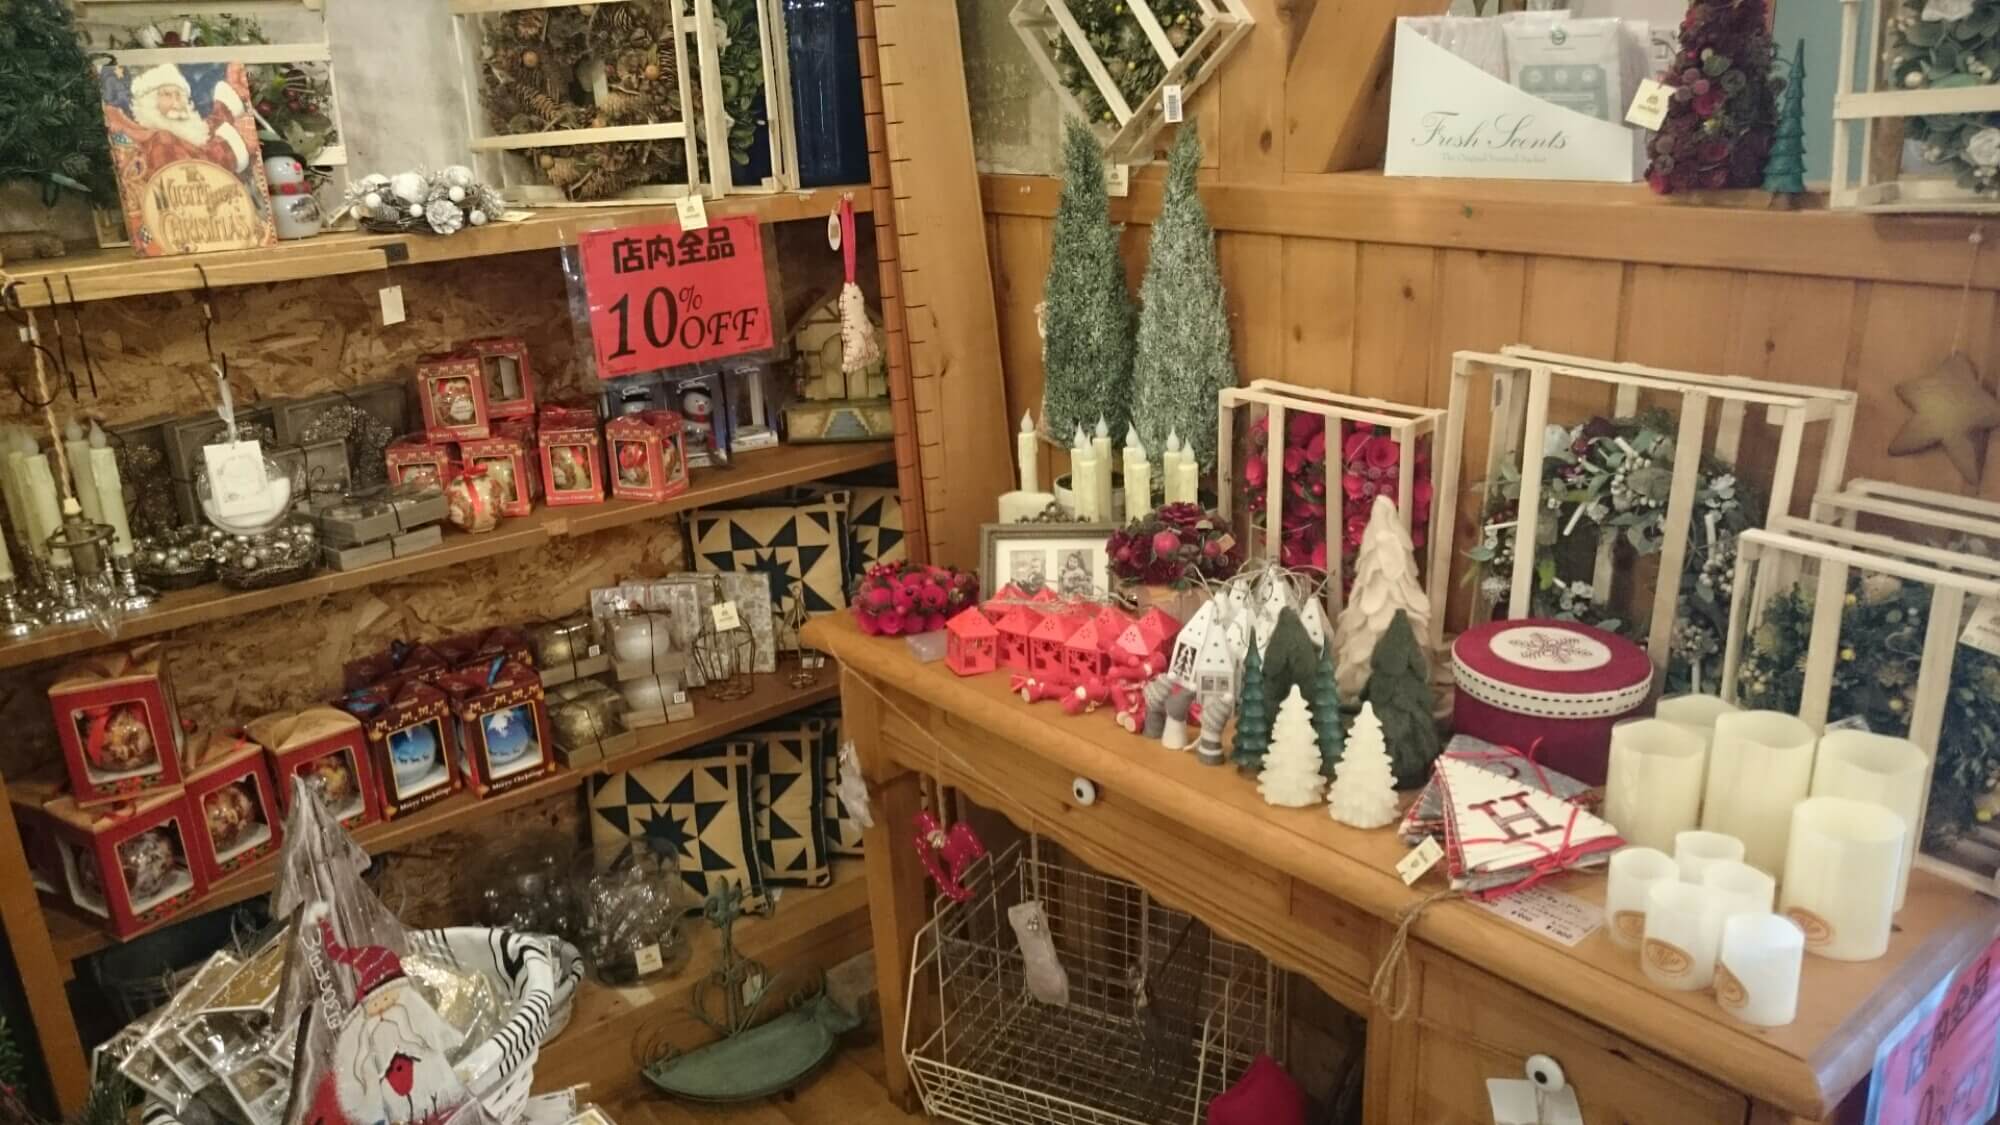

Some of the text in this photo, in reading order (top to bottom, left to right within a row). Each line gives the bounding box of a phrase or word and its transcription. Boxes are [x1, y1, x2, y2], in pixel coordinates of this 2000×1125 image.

[1411, 111, 1571, 150] Fresh Scents
[612, 226, 736, 275] 店内全品
[679, 307, 759, 350] OFF
[1468, 791, 1565, 844] H
